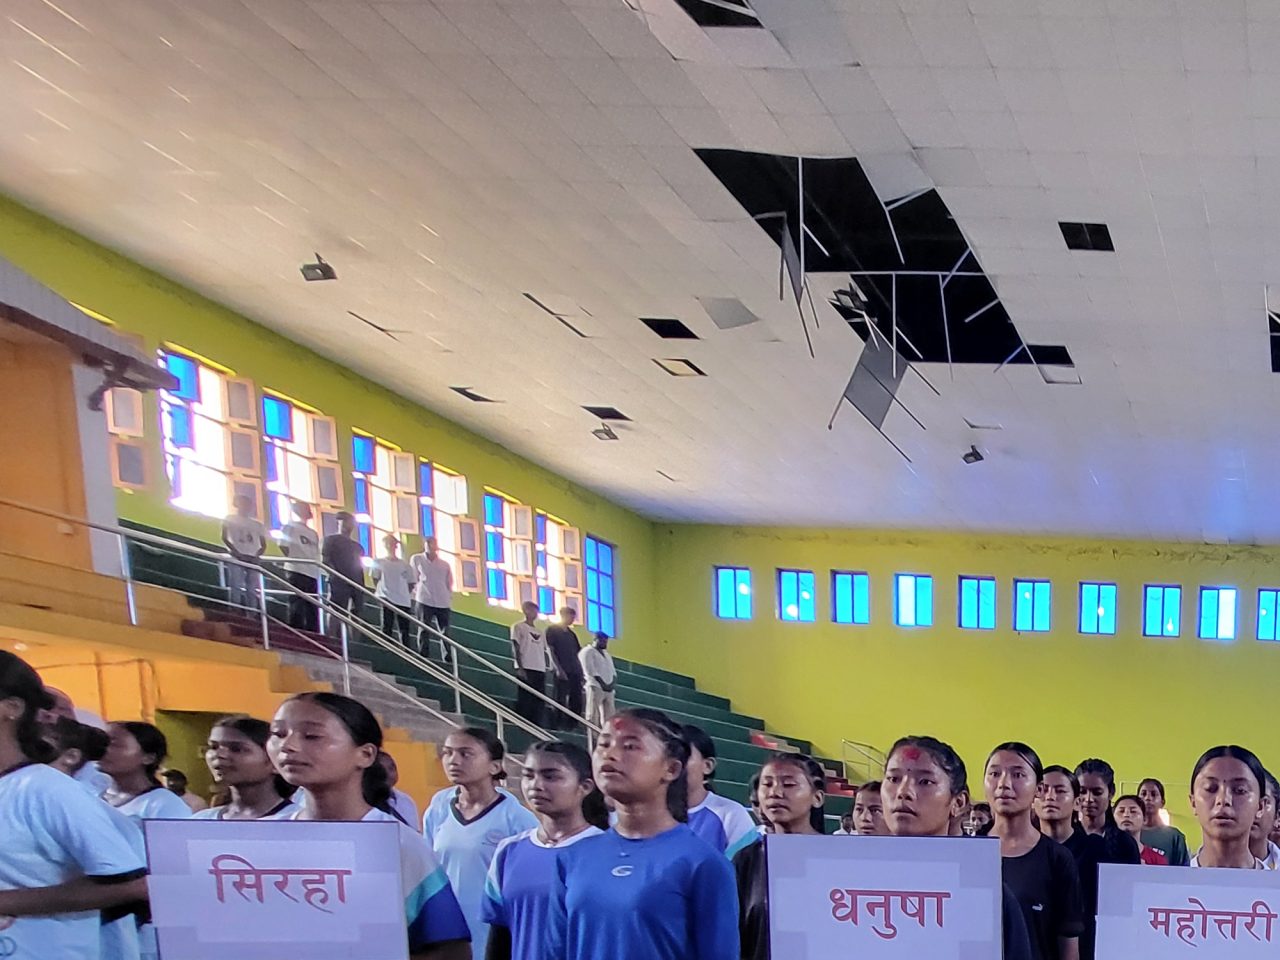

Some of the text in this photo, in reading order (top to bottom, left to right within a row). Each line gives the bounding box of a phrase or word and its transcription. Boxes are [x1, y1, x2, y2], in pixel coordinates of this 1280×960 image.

[208, 854, 352, 914] सिरहा
[830, 888, 951, 939] धनुषा
[1148, 897, 1278, 948] महोत्तरी
